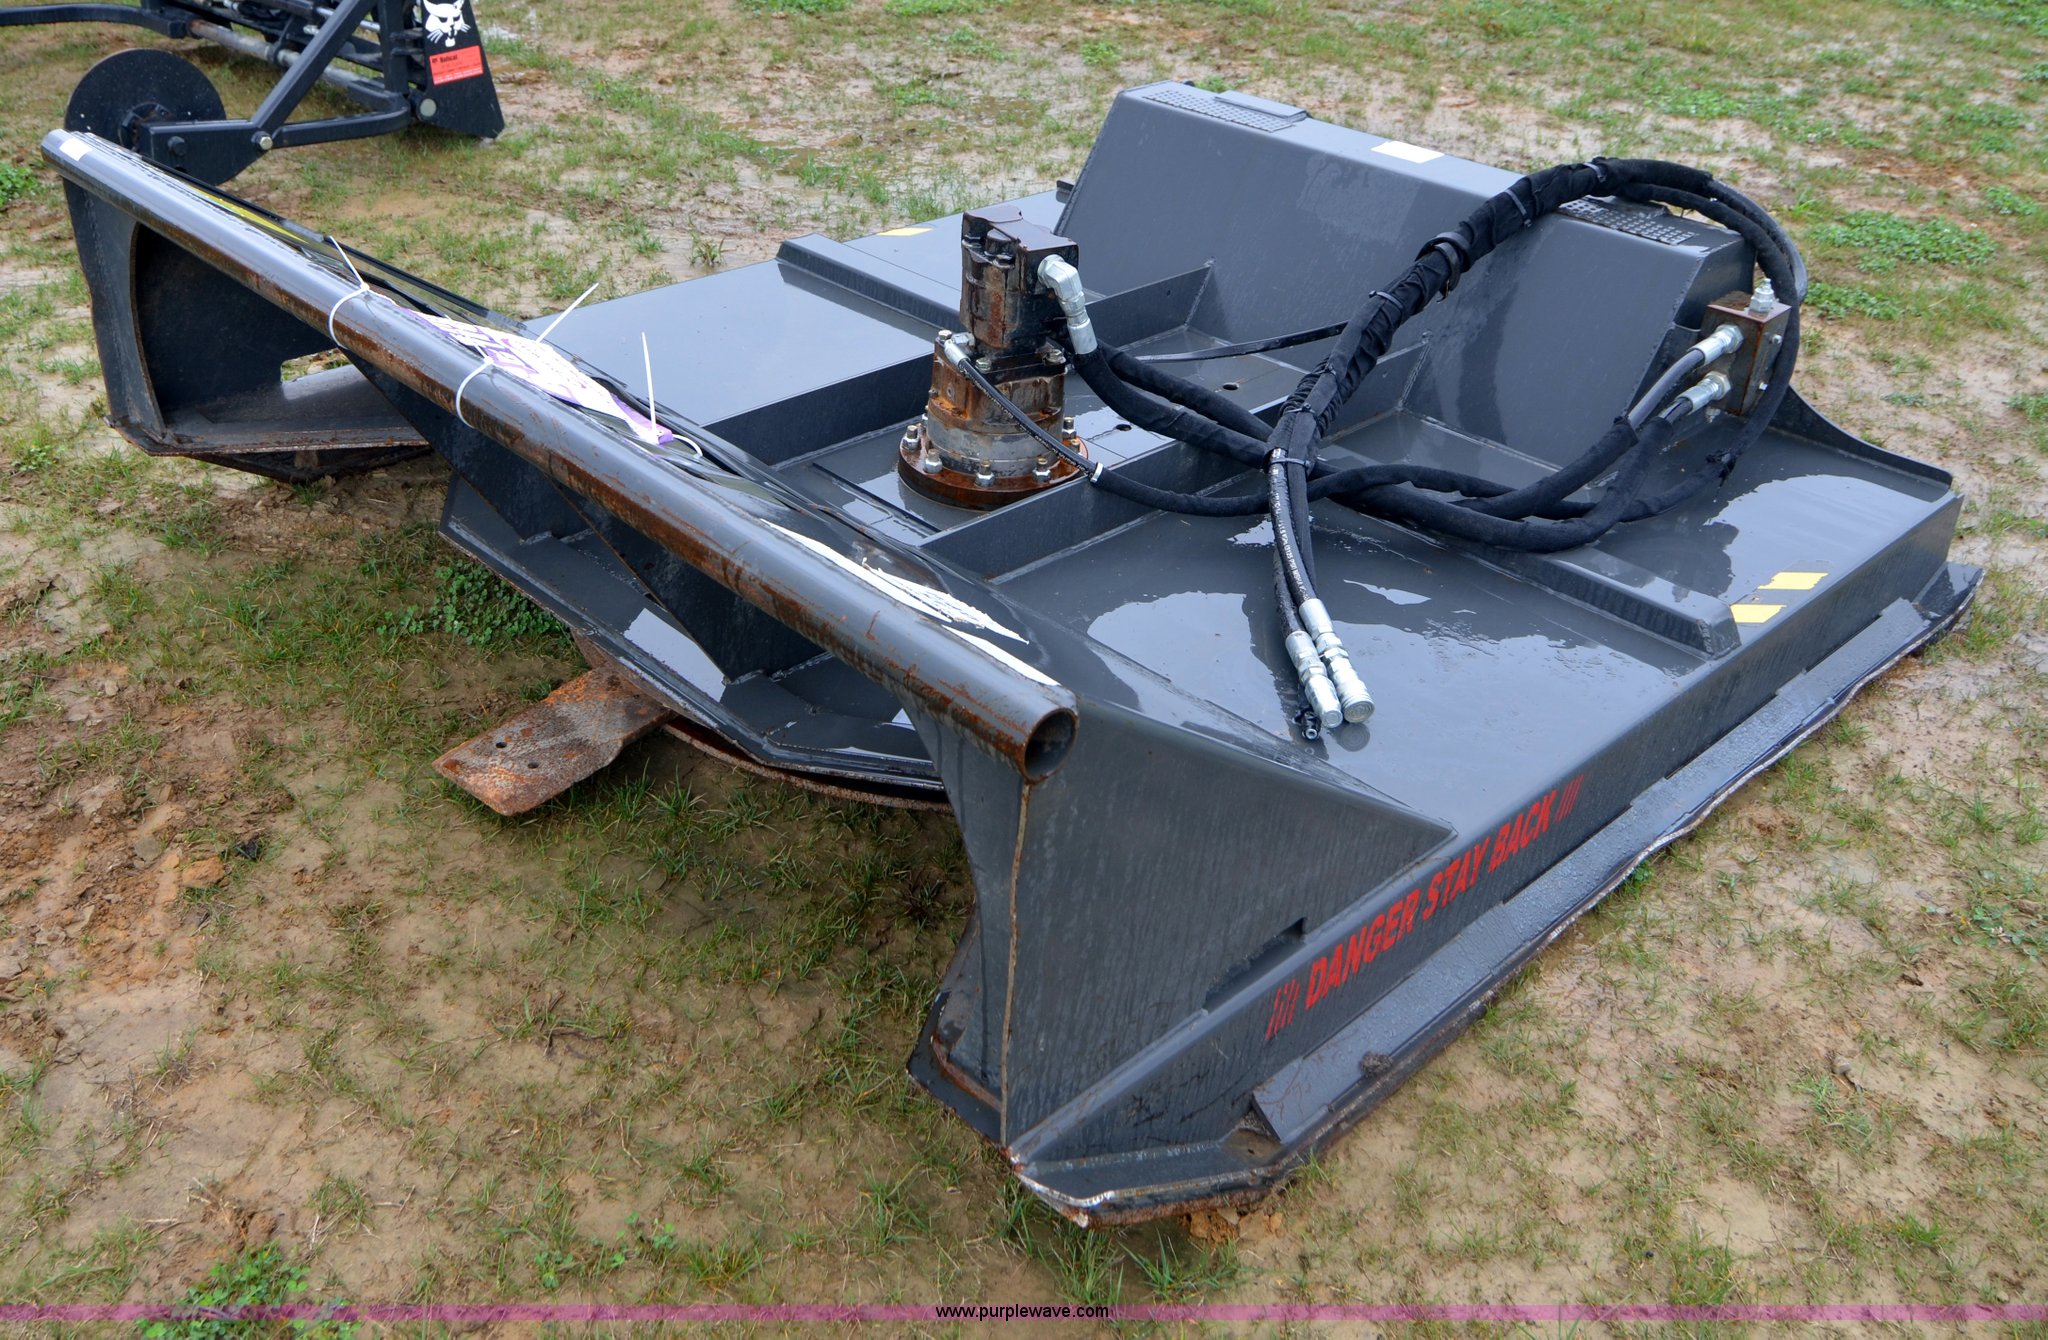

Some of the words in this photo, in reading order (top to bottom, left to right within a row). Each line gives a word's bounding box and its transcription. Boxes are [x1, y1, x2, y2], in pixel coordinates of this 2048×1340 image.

[1305, 888, 1421, 1010] DANGER
[1422, 836, 1491, 921] STAY
[1487, 789, 1558, 874] BACK
